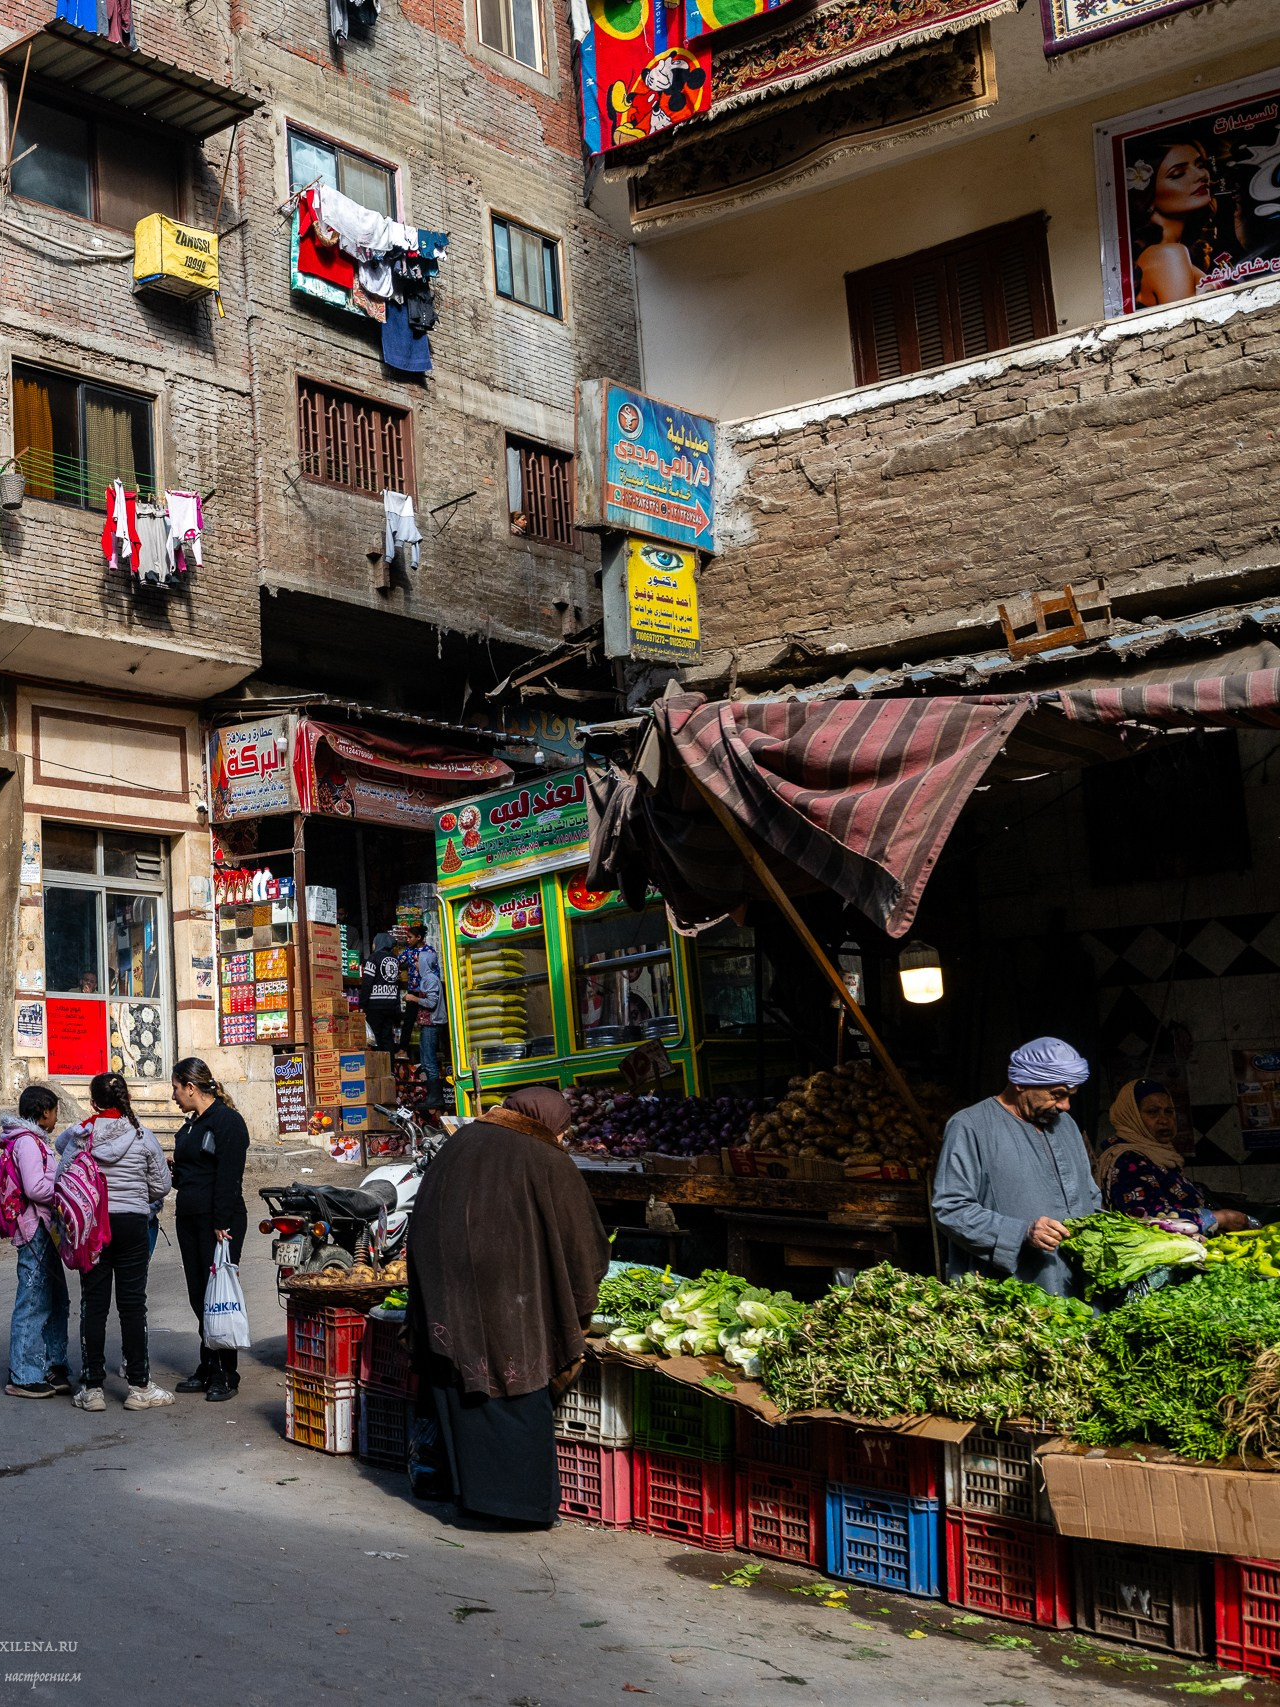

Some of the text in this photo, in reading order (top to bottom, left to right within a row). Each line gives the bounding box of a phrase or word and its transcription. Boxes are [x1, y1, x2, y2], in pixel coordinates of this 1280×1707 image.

[175, 229, 211, 255] ZANUSSI
[184, 255, 207, 273] 19999
[1197, 261, 1232, 289] الشعر
[1232, 257, 1269, 280] مشاكل
[666, 416, 710, 458] صيدلية
[645, 474, 667, 496] طبية
[668, 481, 692, 502] خدمة
[647, 574, 678, 589] دكتور
[633, 586, 692, 608] أحمد محمد توفيق
[253, 727, 273, 742] عطارة
[226, 737, 287, 783] البركة
[489, 773, 587, 834] لعندليب
[540, 819, 568, 836] الشرقية
[498, 890, 542, 917] العندليب
